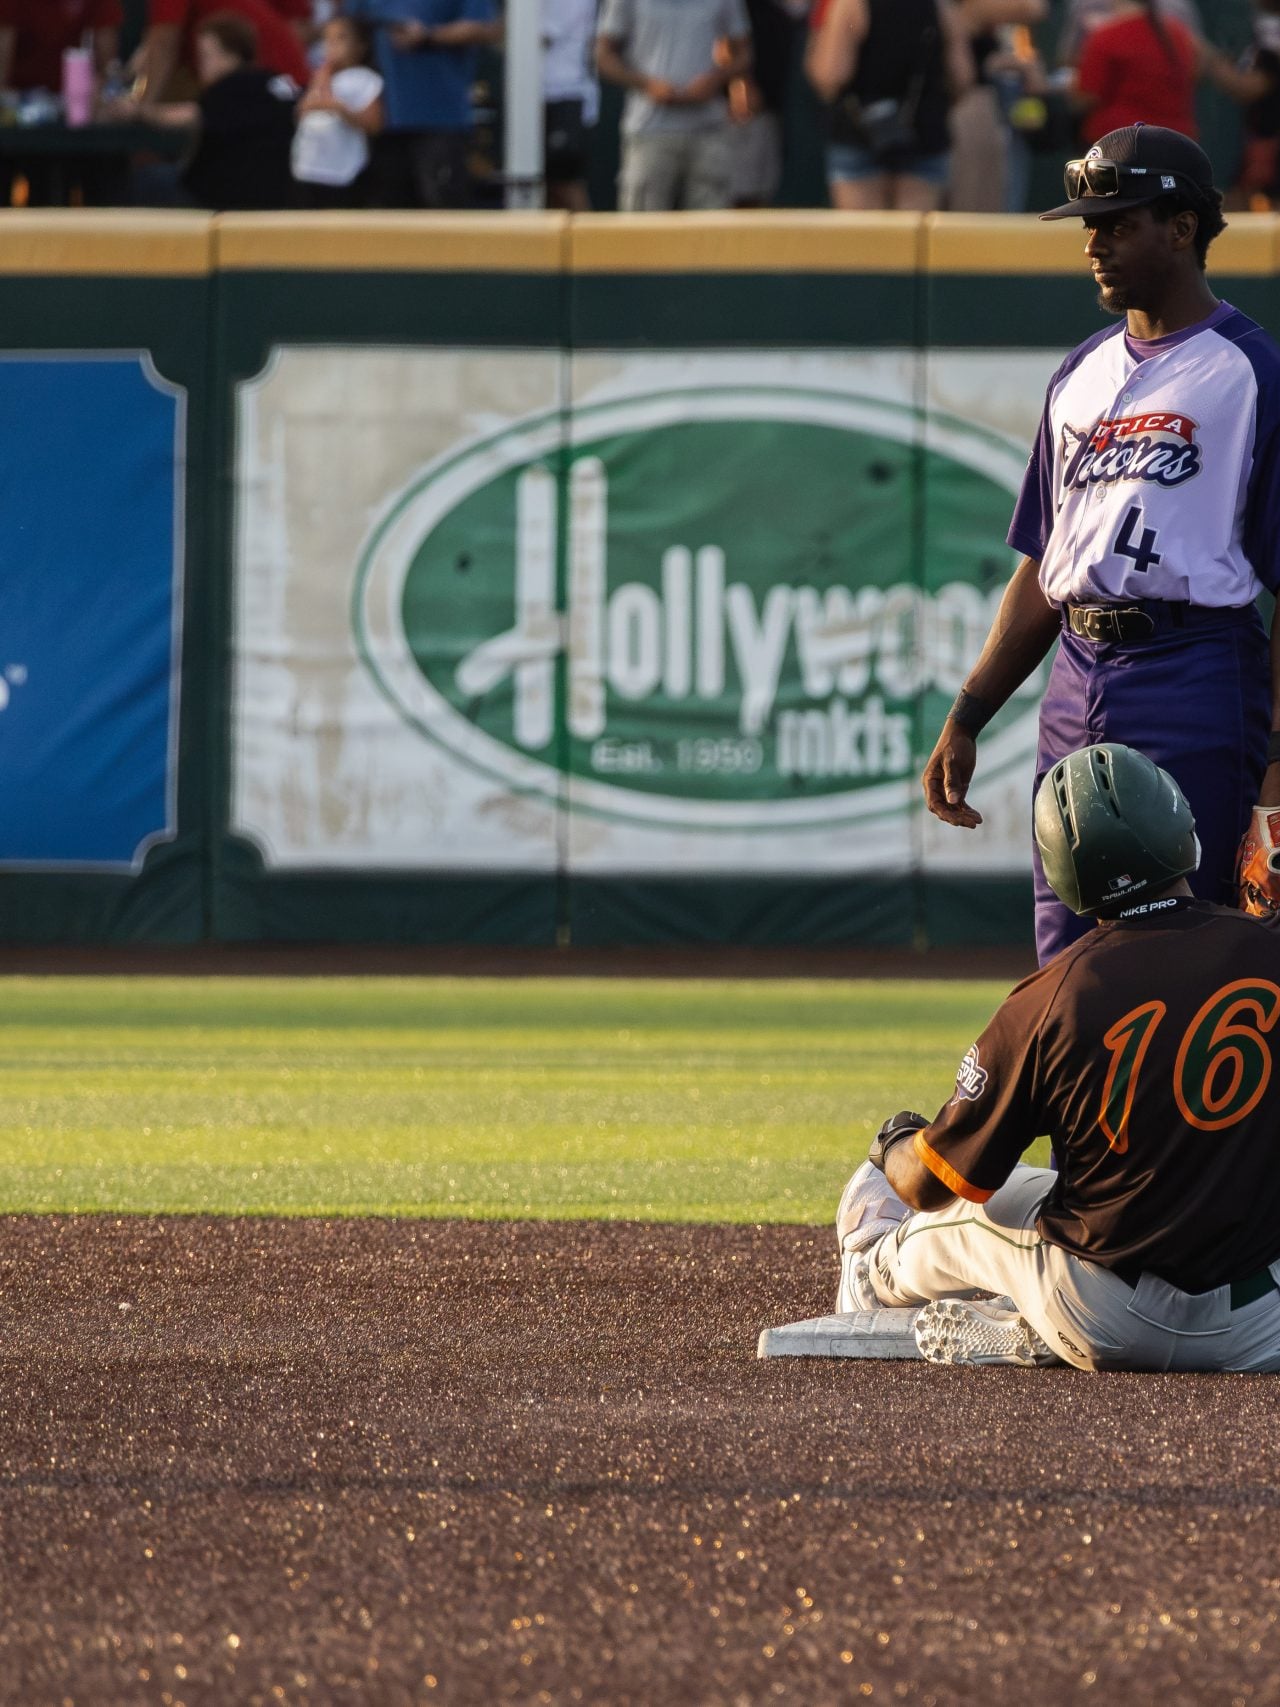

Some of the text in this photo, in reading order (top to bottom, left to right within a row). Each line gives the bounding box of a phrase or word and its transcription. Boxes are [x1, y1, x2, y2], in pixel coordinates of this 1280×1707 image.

[1113, 506, 1161, 573] 4
[455, 455, 1042, 750] Hollywoo
[776, 695, 913, 778] mkts
[1101, 879, 1148, 901] RAWLINGS
[1120, 898, 1177, 918] NIKE PRO
